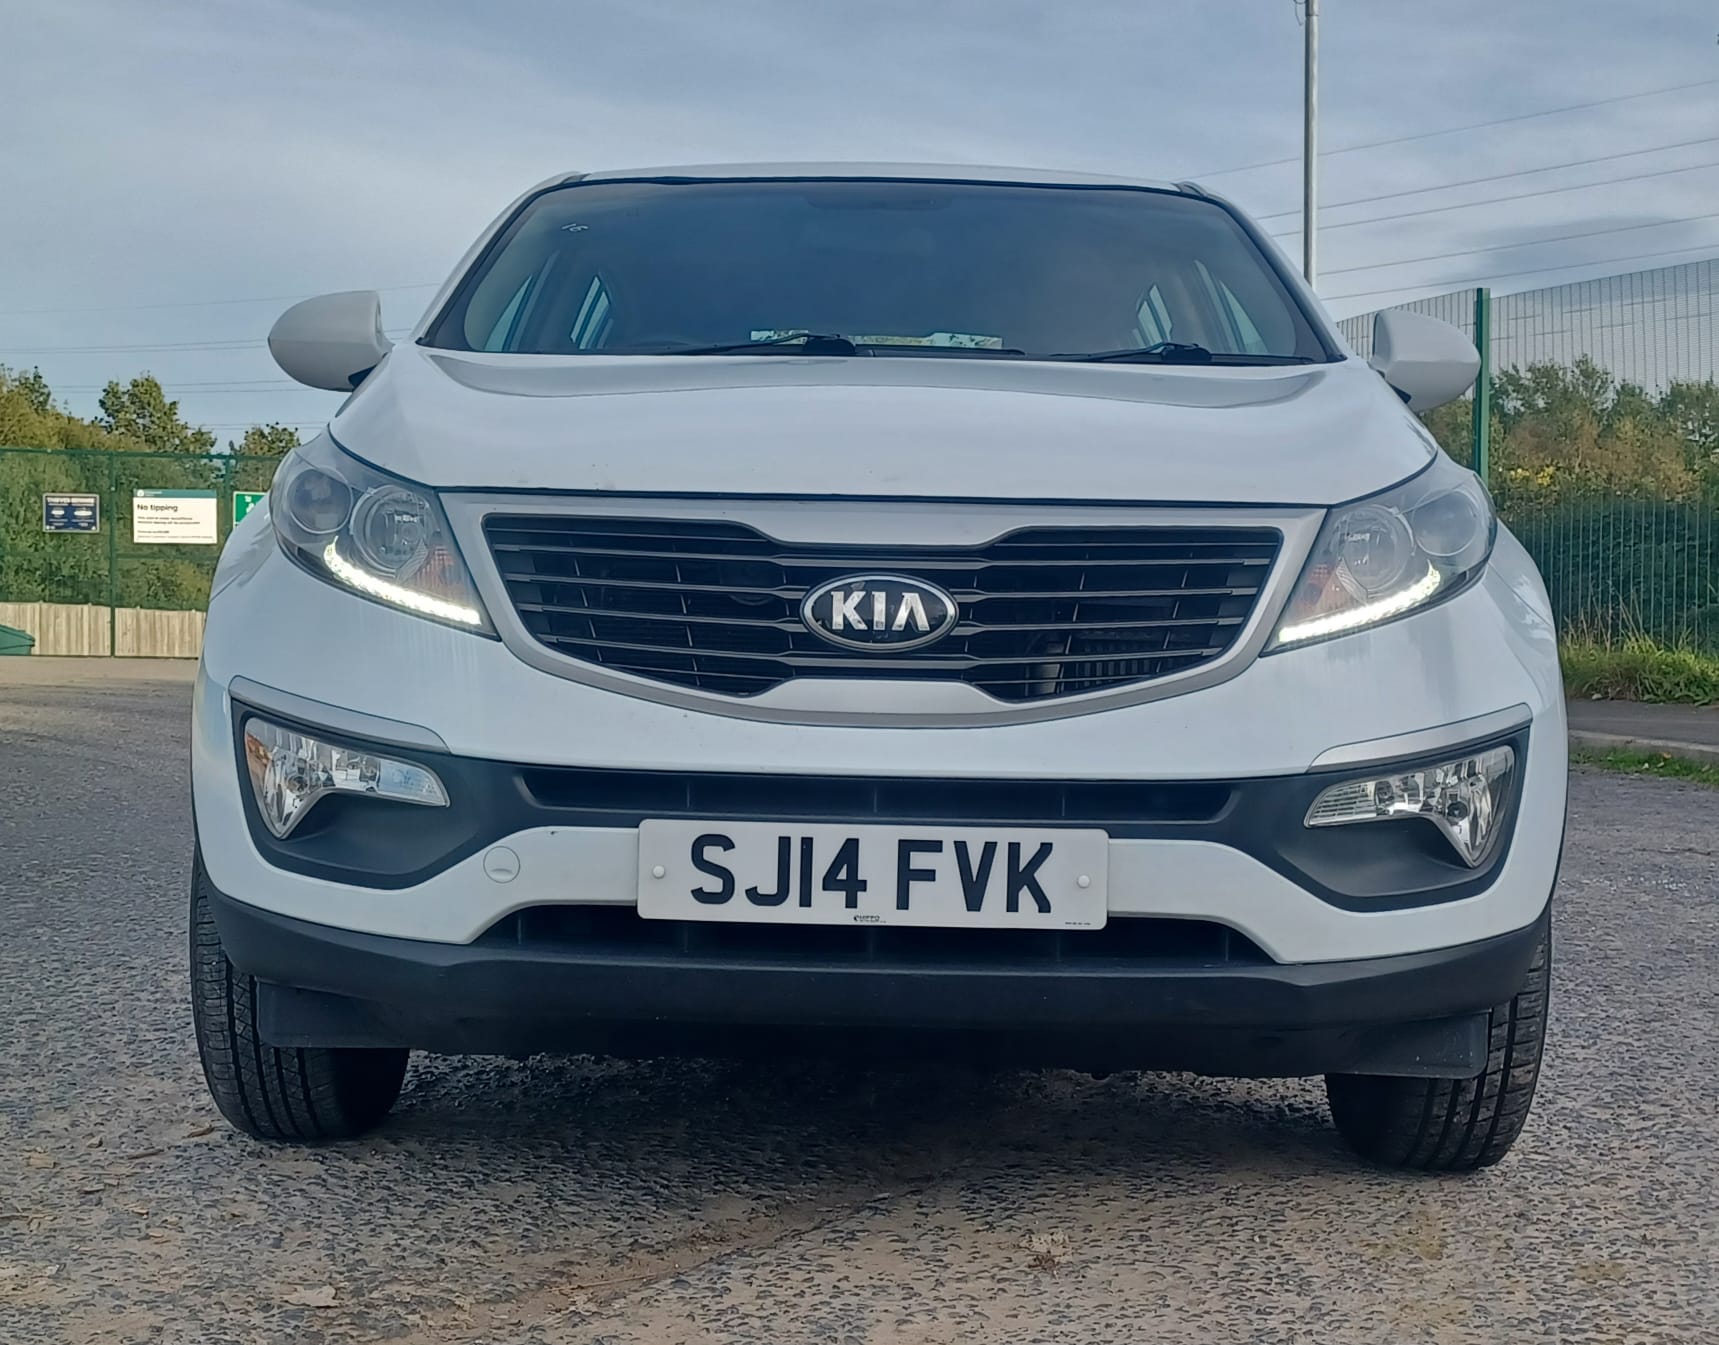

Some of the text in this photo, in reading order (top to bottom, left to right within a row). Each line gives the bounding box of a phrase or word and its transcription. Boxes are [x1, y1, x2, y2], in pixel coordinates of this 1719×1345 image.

[150, 504, 178, 512] tipping
[831, 591, 930, 632] KIA
[691, 834, 1053, 915] SJ14 FVK
